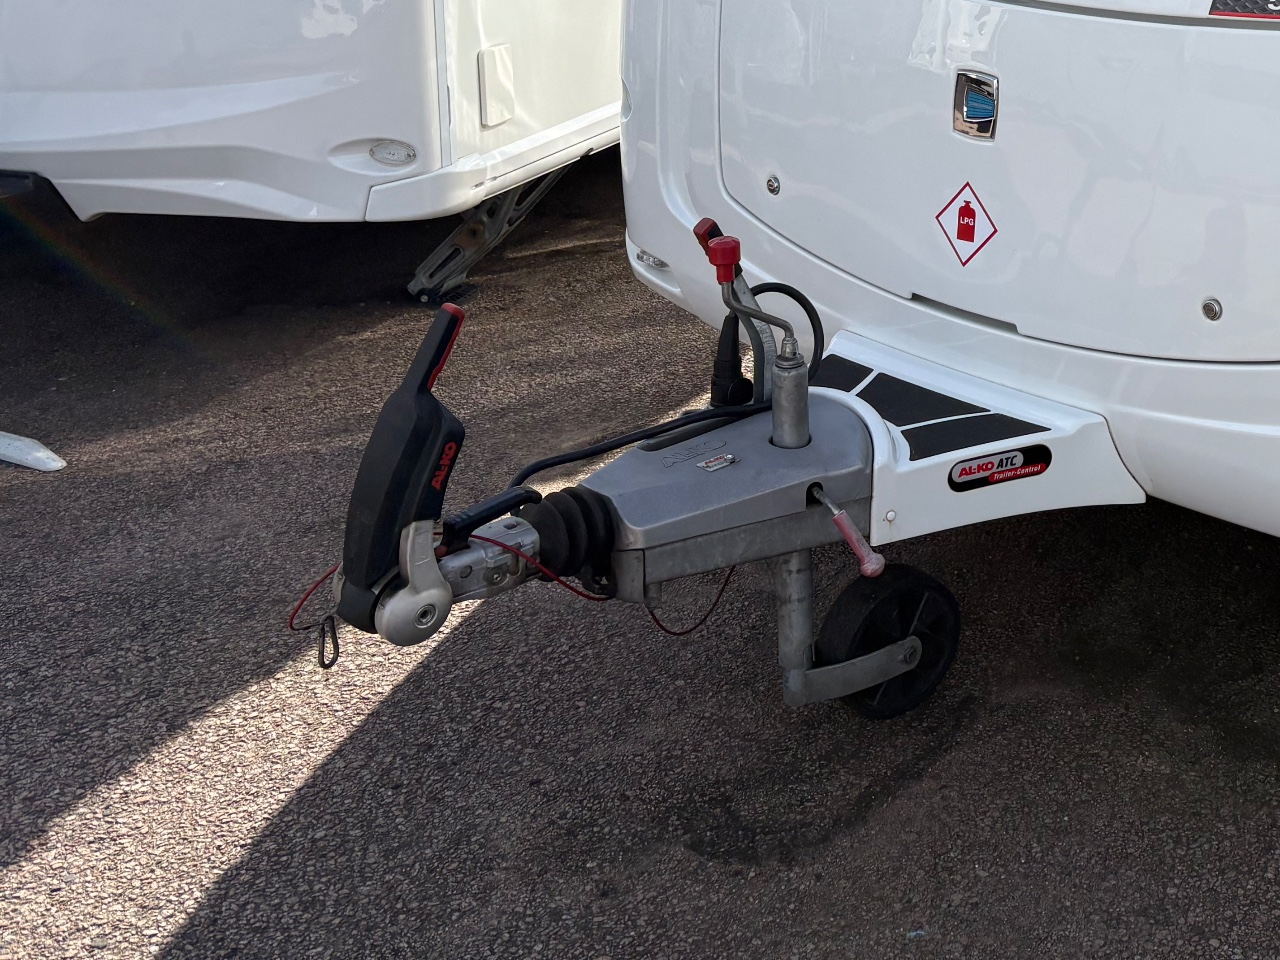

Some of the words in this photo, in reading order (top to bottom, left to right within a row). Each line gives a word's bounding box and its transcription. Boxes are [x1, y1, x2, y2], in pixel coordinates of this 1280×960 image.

[959, 216, 974, 226] LPG
[432, 441, 457, 490] AL-KO
[957, 461, 995, 478] AL-KO
[996, 455, 1018, 469] ATC
[993, 464, 1041, 480] Trailer-Control
